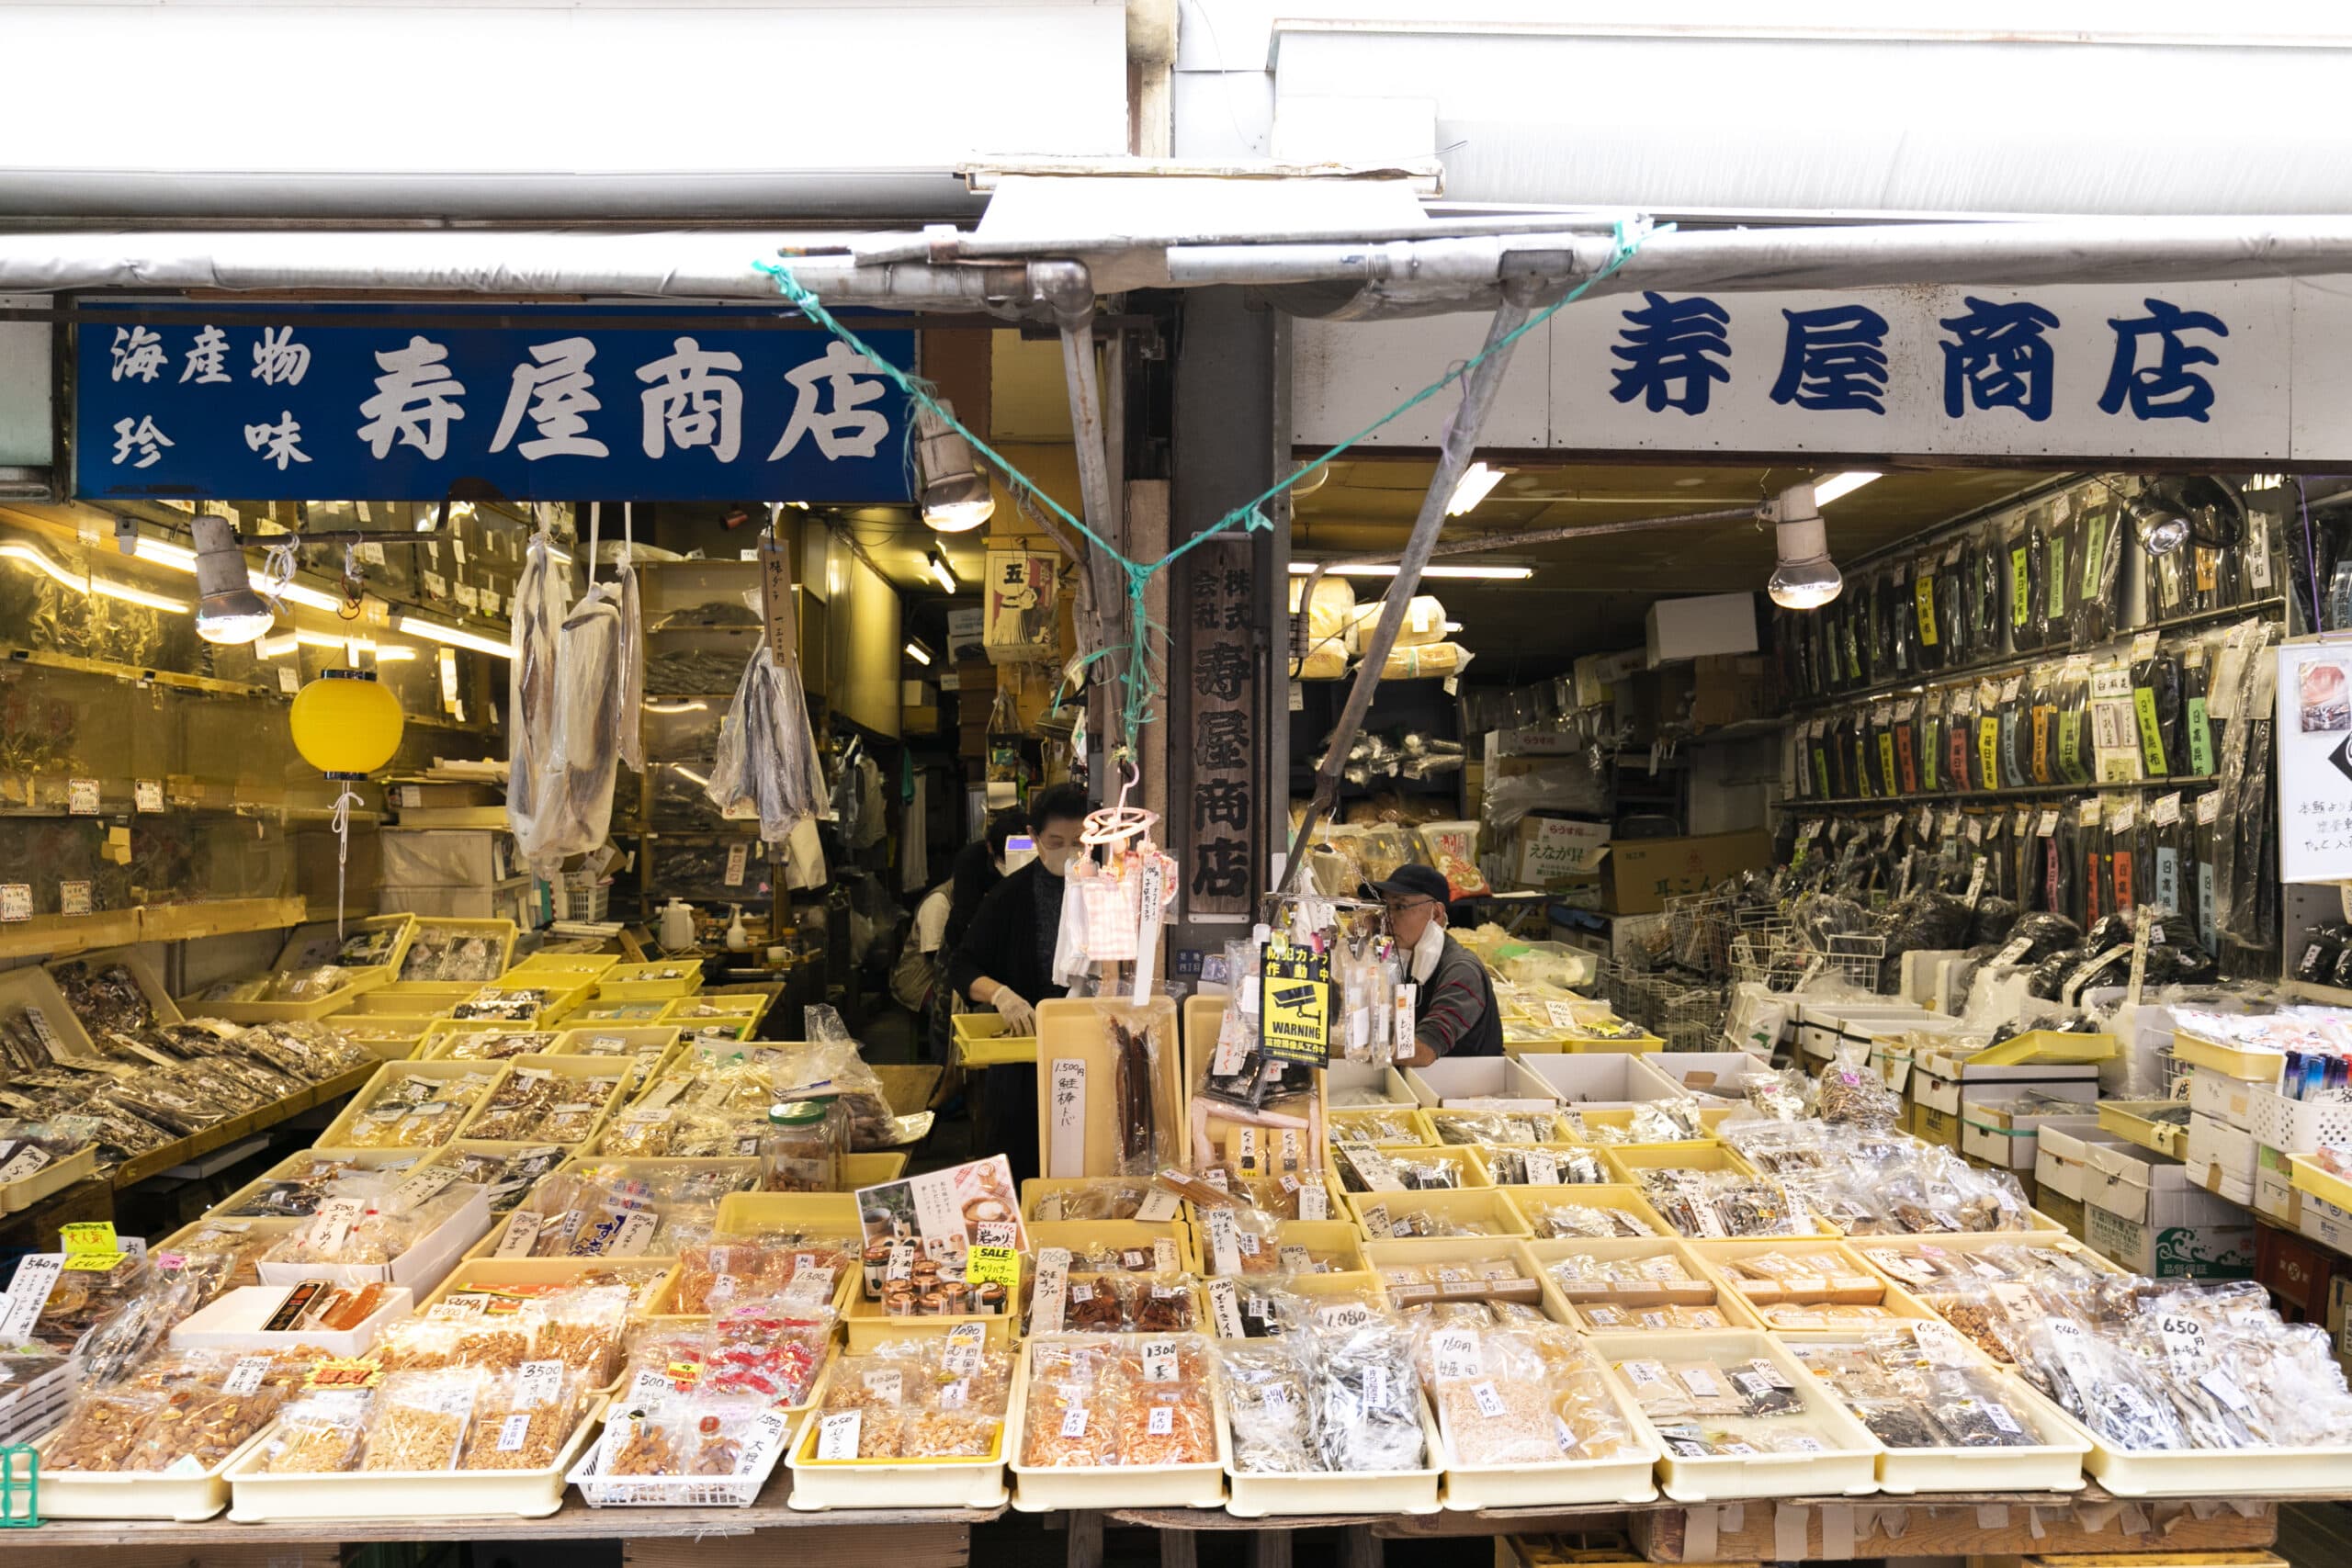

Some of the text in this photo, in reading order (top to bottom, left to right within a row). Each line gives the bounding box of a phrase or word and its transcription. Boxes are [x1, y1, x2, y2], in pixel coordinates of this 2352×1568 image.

[111, 324, 311, 385] 海産物
[1610, 292, 2229, 423] 寿屋商店
[358, 334, 889, 462] 寿屋商店
[111, 410, 312, 470] 珍味
[1266, 964, 1329, 983] 作動中
[1272, 1021, 1321, 1040] WARNING
[1057, 1077, 1080, 1127] 鮭棒トバ
[978, 1229, 1011, 1246] 岩のり
[980, 1247, 1010, 1258] SALE
[2163, 1316, 2205, 1345] 650円
[1147, 1344, 1177, 1358] 1300
